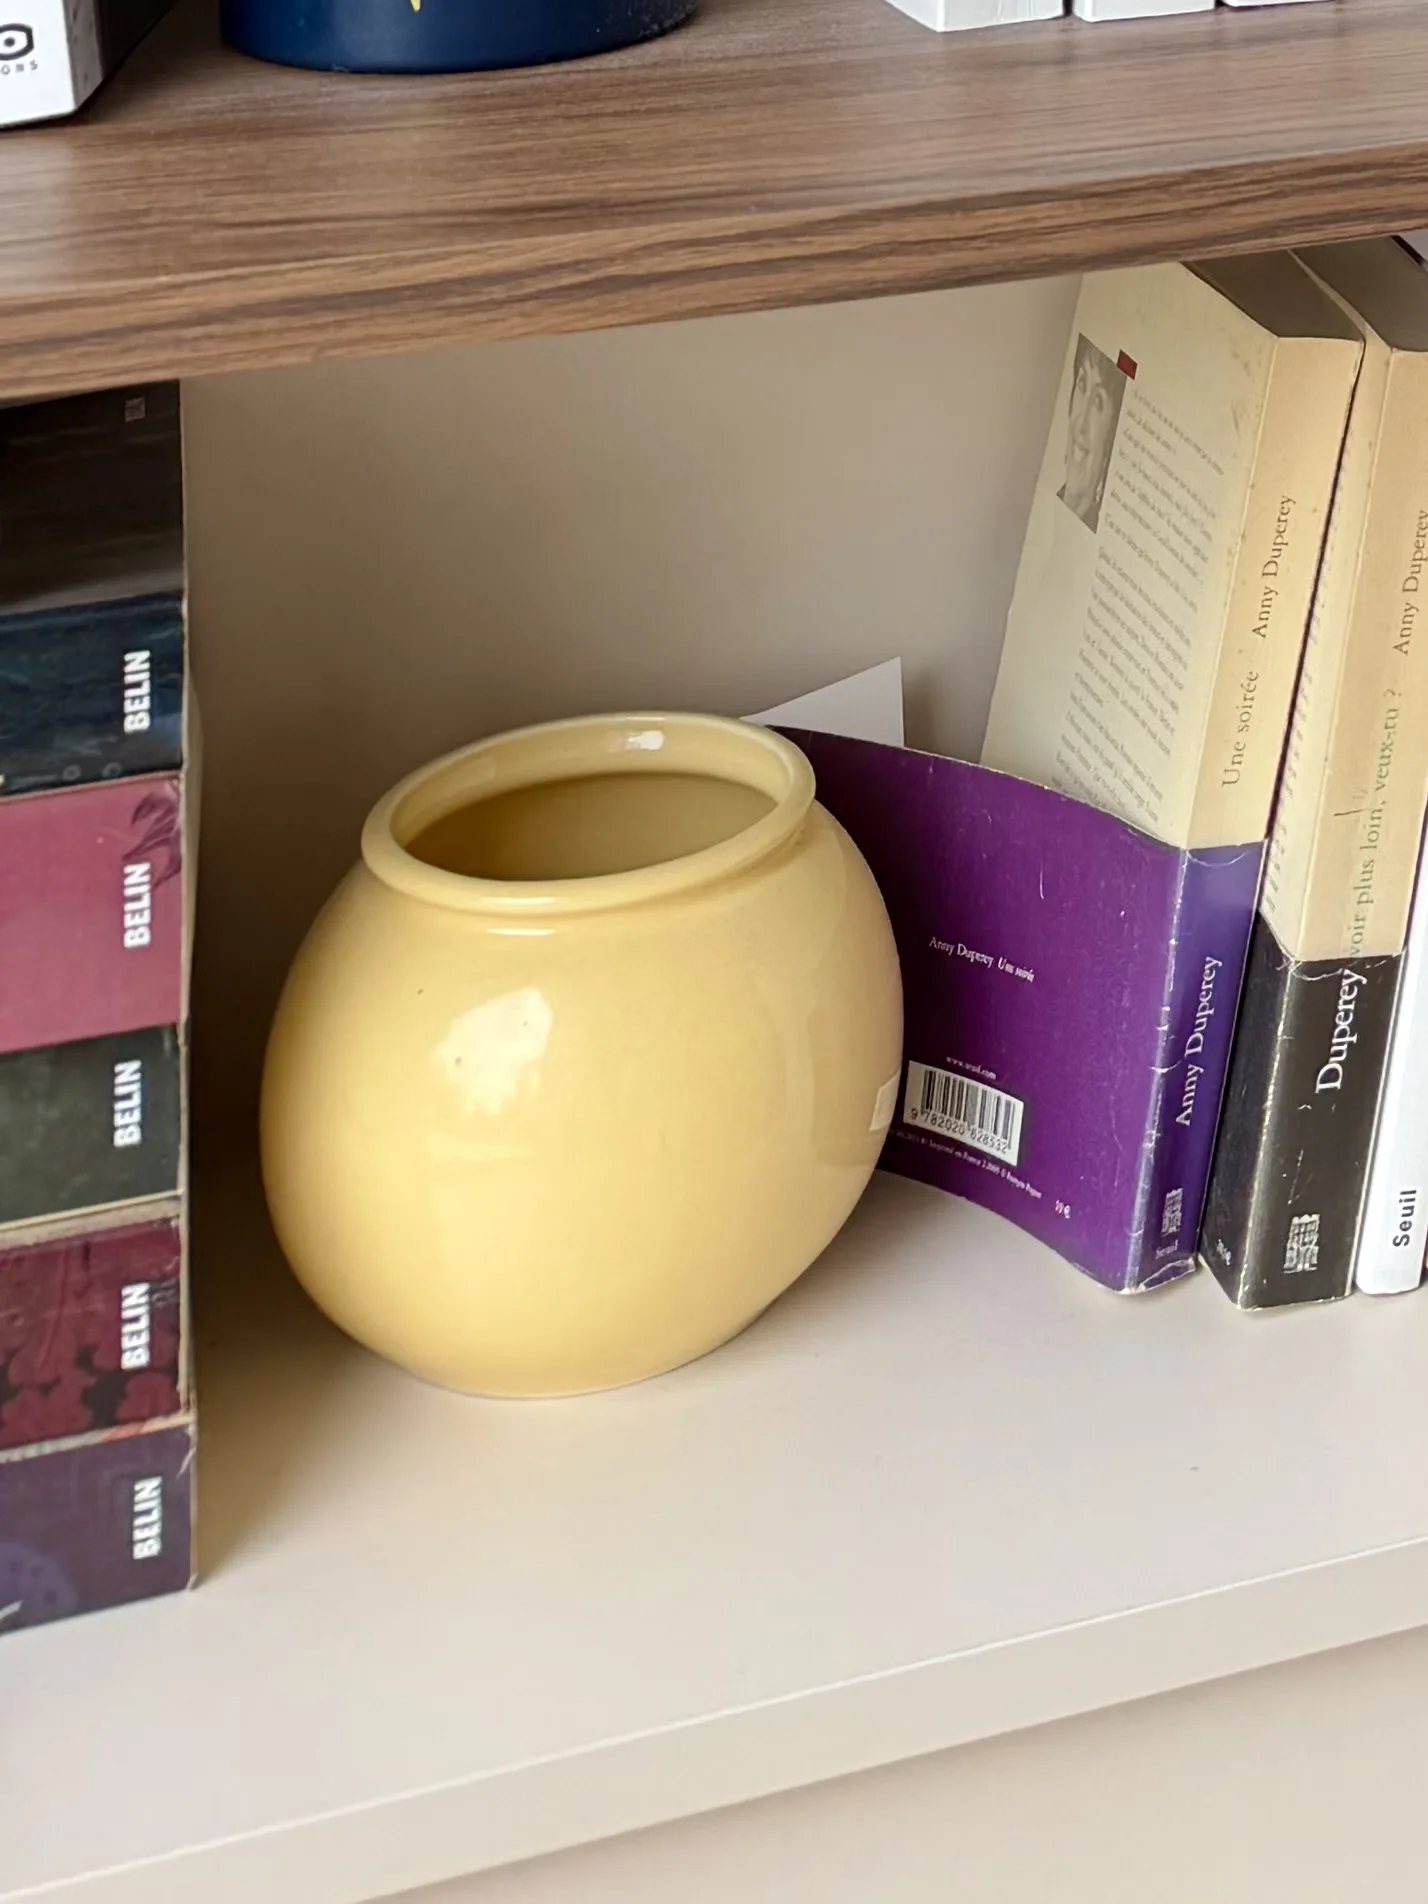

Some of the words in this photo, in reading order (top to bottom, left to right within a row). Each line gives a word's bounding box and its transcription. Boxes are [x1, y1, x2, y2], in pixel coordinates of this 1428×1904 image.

[1261, 497, 1296, 577] Duperey
[1251, 586, 1278, 638] Anny
[1393, 602, 1419, 655] Anny
[123, 649, 151, 733] BELIN
[1221, 741, 1246, 786] Une
[1237, 671, 1258, 733] soirée
[124, 862, 152, 949] BELIN
[1184, 956, 1222, 1056] Duperey
[1315, 968, 1368, 1093] Duperey
[113, 1060, 142, 1148] BELIN
[1175, 1064, 1204, 1126] Anny
[1392, 1189, 1417, 1247] Seuil
[121, 1282, 151, 1371] BELIN
[133, 1476, 162, 1560] BELIN
